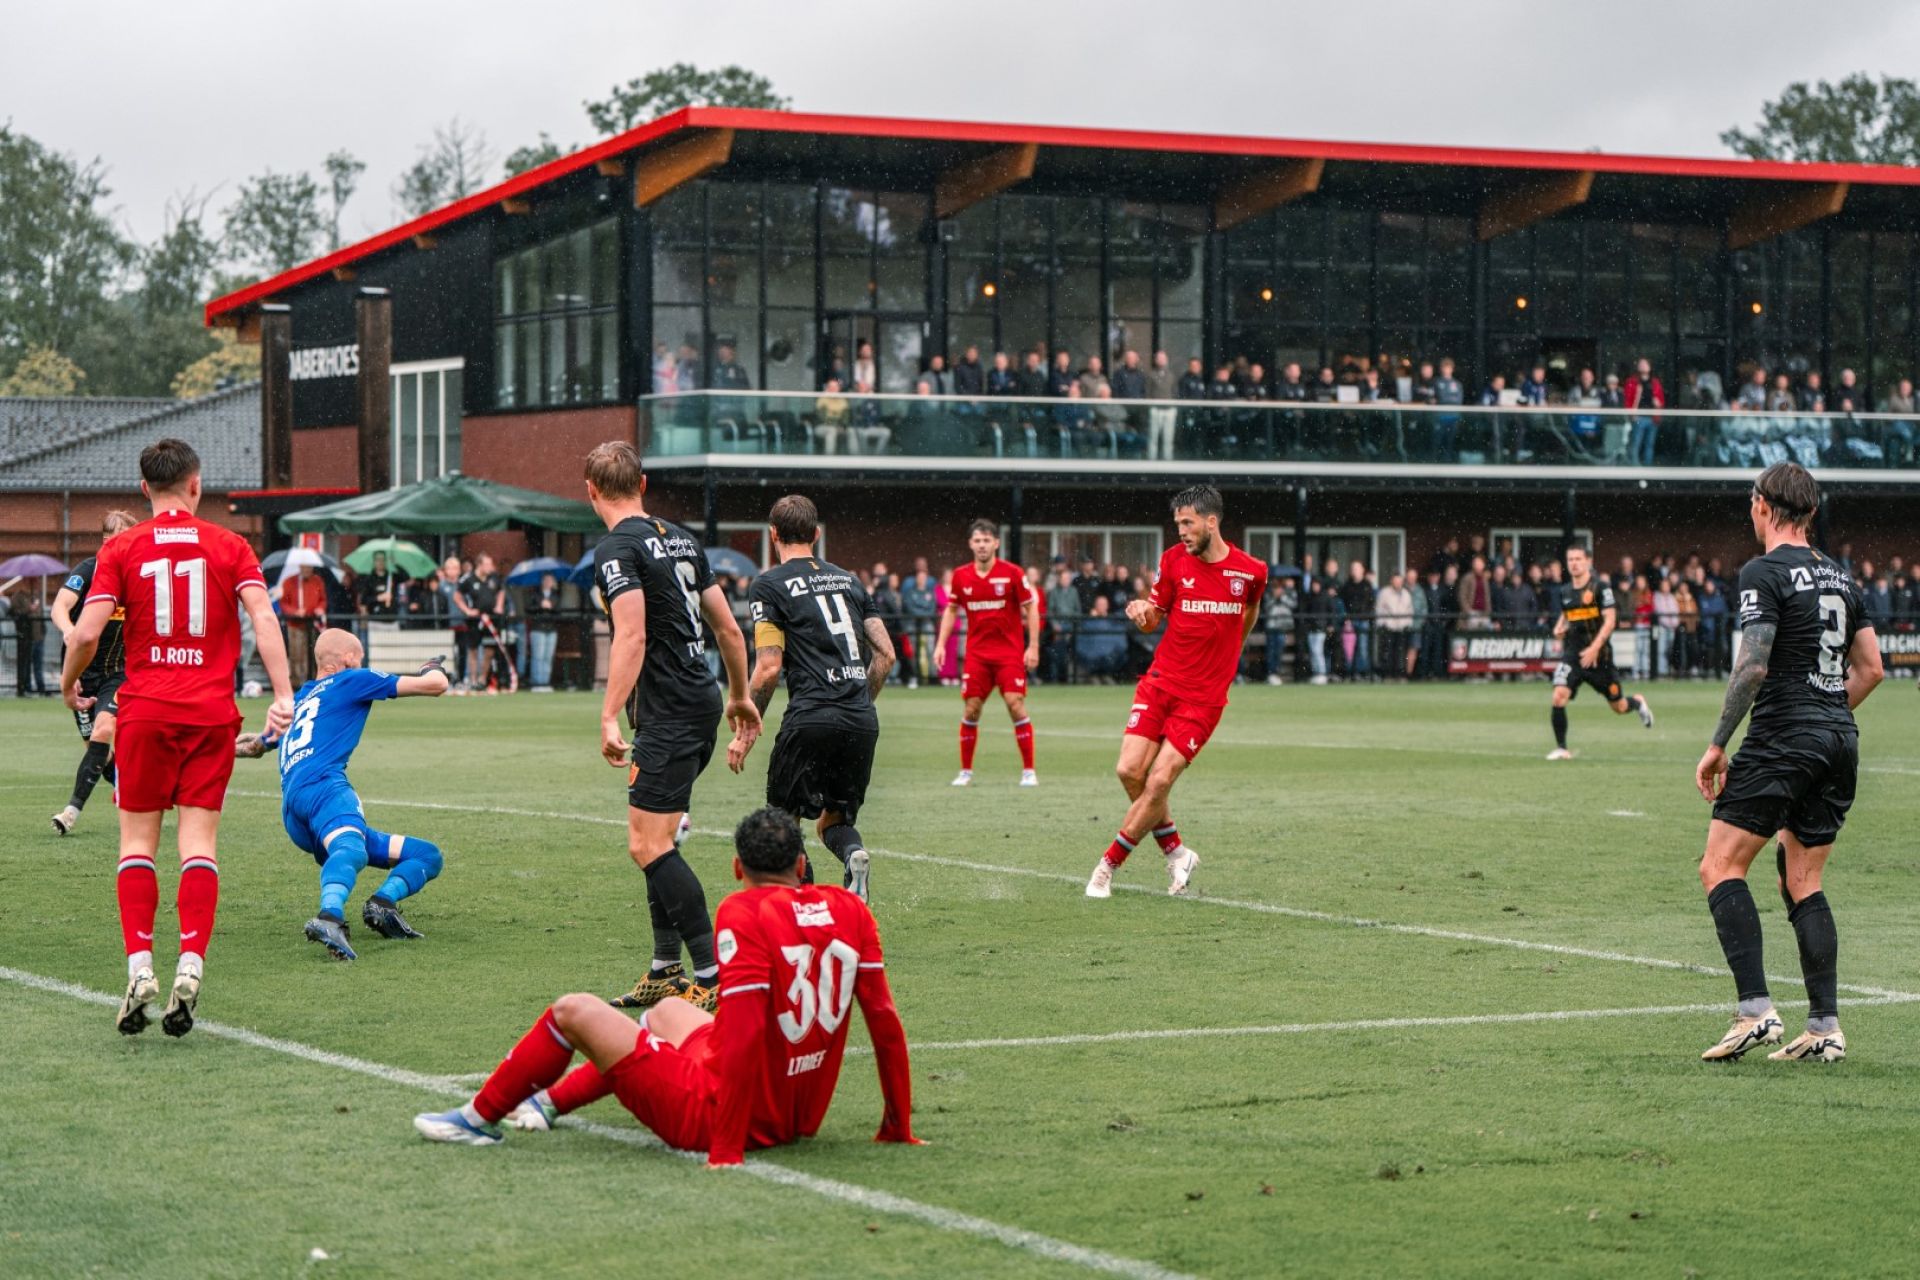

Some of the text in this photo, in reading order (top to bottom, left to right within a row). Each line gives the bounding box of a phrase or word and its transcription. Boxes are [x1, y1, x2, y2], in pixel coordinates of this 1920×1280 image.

[139, 557, 207, 638] 11
[815, 593, 860, 661] 4
[1181, 599, 1242, 615] ELEKTRAMAT
[1468, 638, 1545, 660] REGIOPLAN
[1818, 594, 1847, 676] 2
[826, 667, 841, 683] K.
[777, 938, 861, 1045] 30
